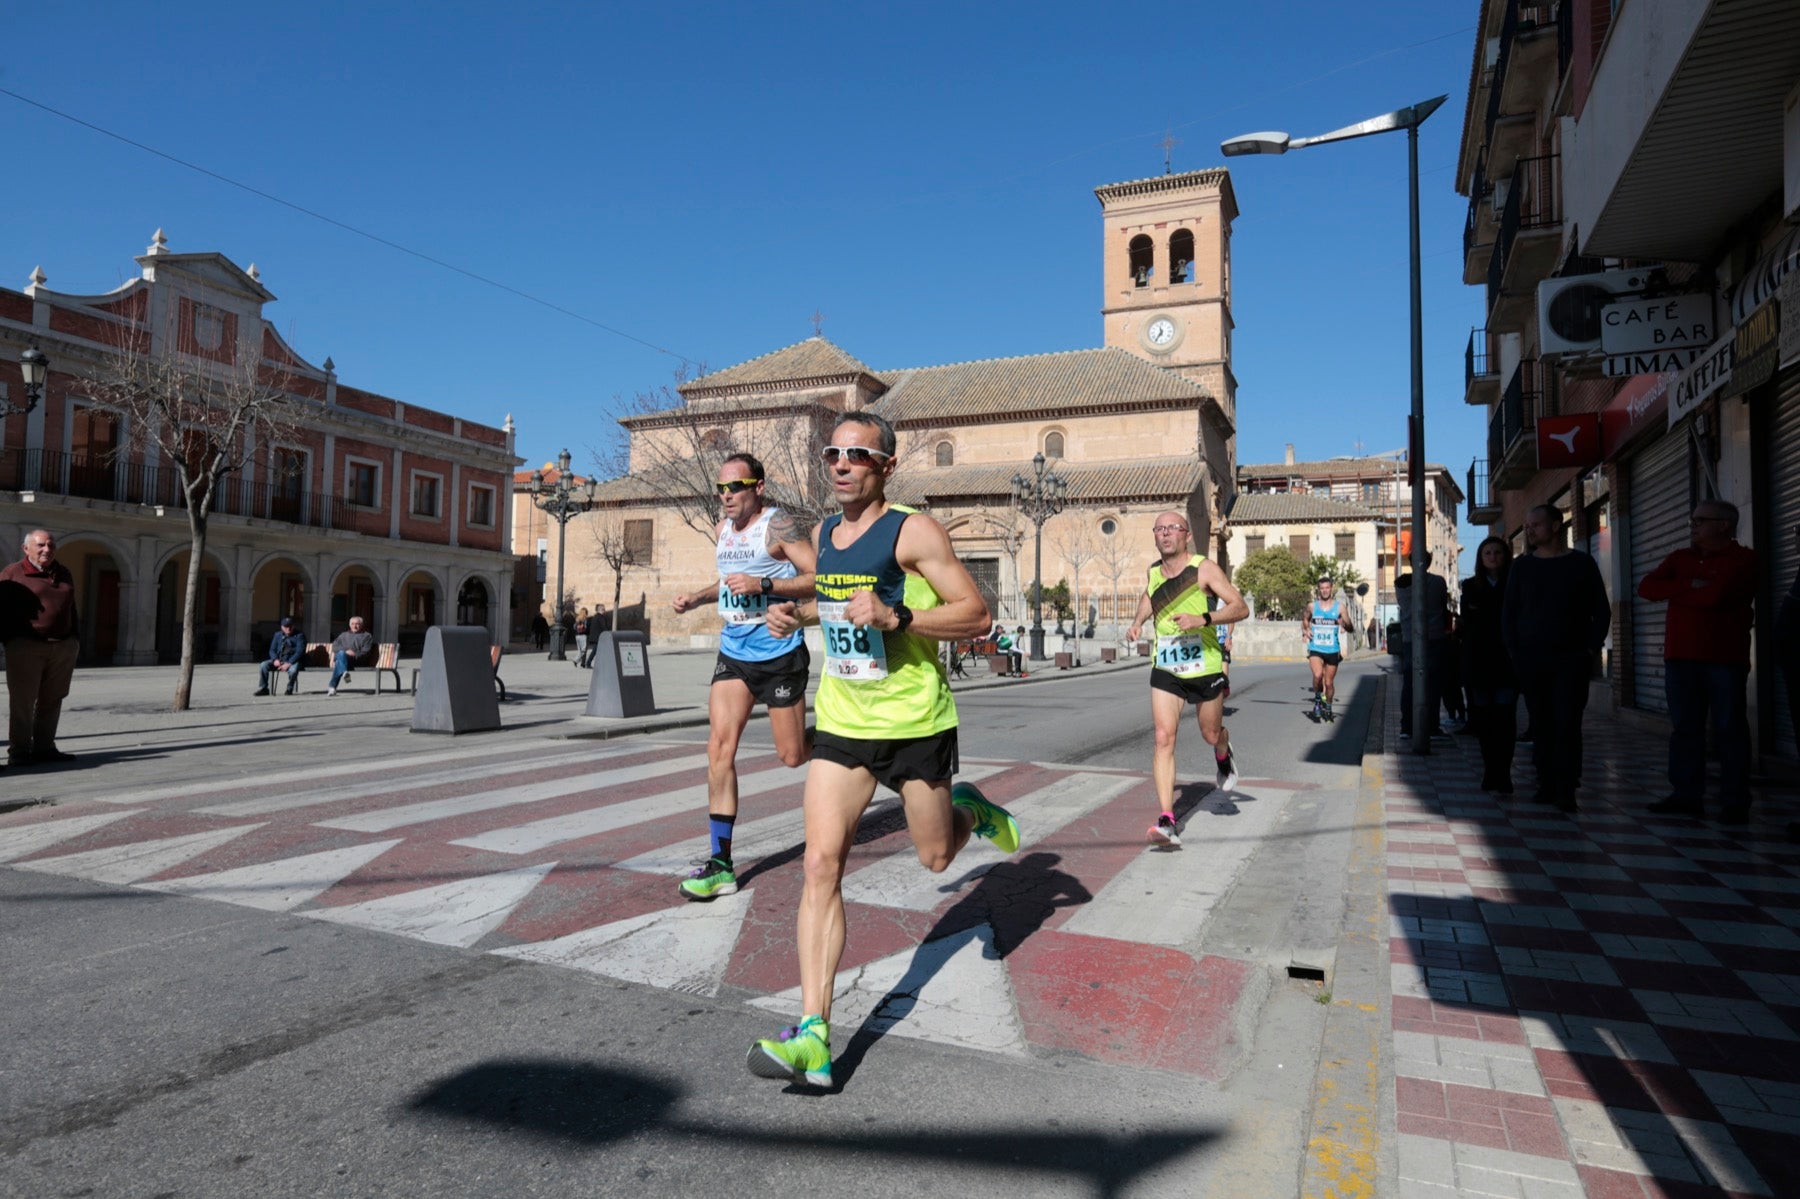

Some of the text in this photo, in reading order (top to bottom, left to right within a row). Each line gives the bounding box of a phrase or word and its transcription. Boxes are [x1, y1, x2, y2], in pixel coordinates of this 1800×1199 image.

[1605, 301, 1678, 326] CAFÉ
[1653, 324, 1708, 344] BAR
[828, 626, 870, 655] 658
[1160, 645, 1202, 663] 1132
